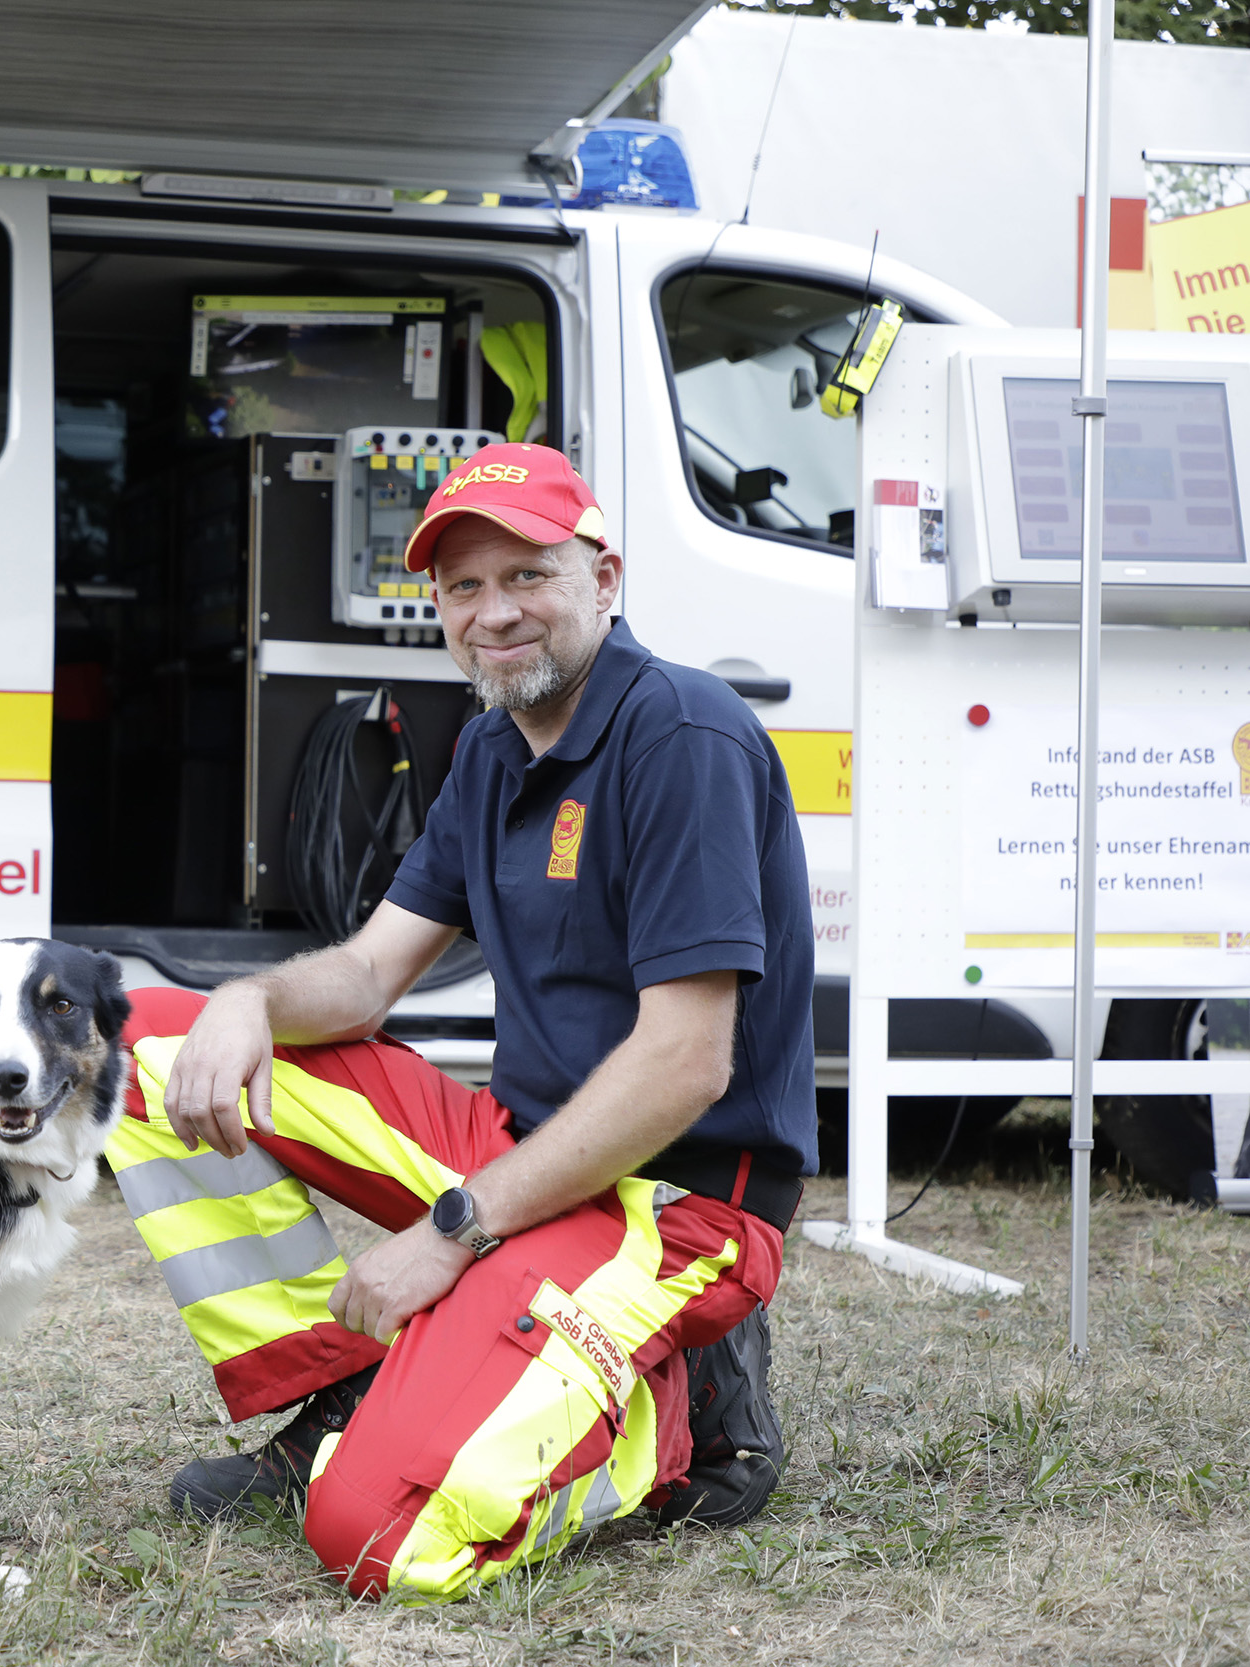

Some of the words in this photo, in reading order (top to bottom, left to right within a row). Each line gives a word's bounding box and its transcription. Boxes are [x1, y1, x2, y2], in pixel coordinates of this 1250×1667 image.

[459, 463, 530, 490] ASB
[1143, 747, 1173, 764] der
[1179, 748, 1215, 764] ASB
[998, 837, 1065, 854] Lernen
[1107, 842, 1162, 854] unser
[1124, 873, 1203, 890] kennen!
[550, 1310, 581, 1341] ASB
[581, 1336, 623, 1392] Kronach
[587, 1322, 625, 1369] Griebel
